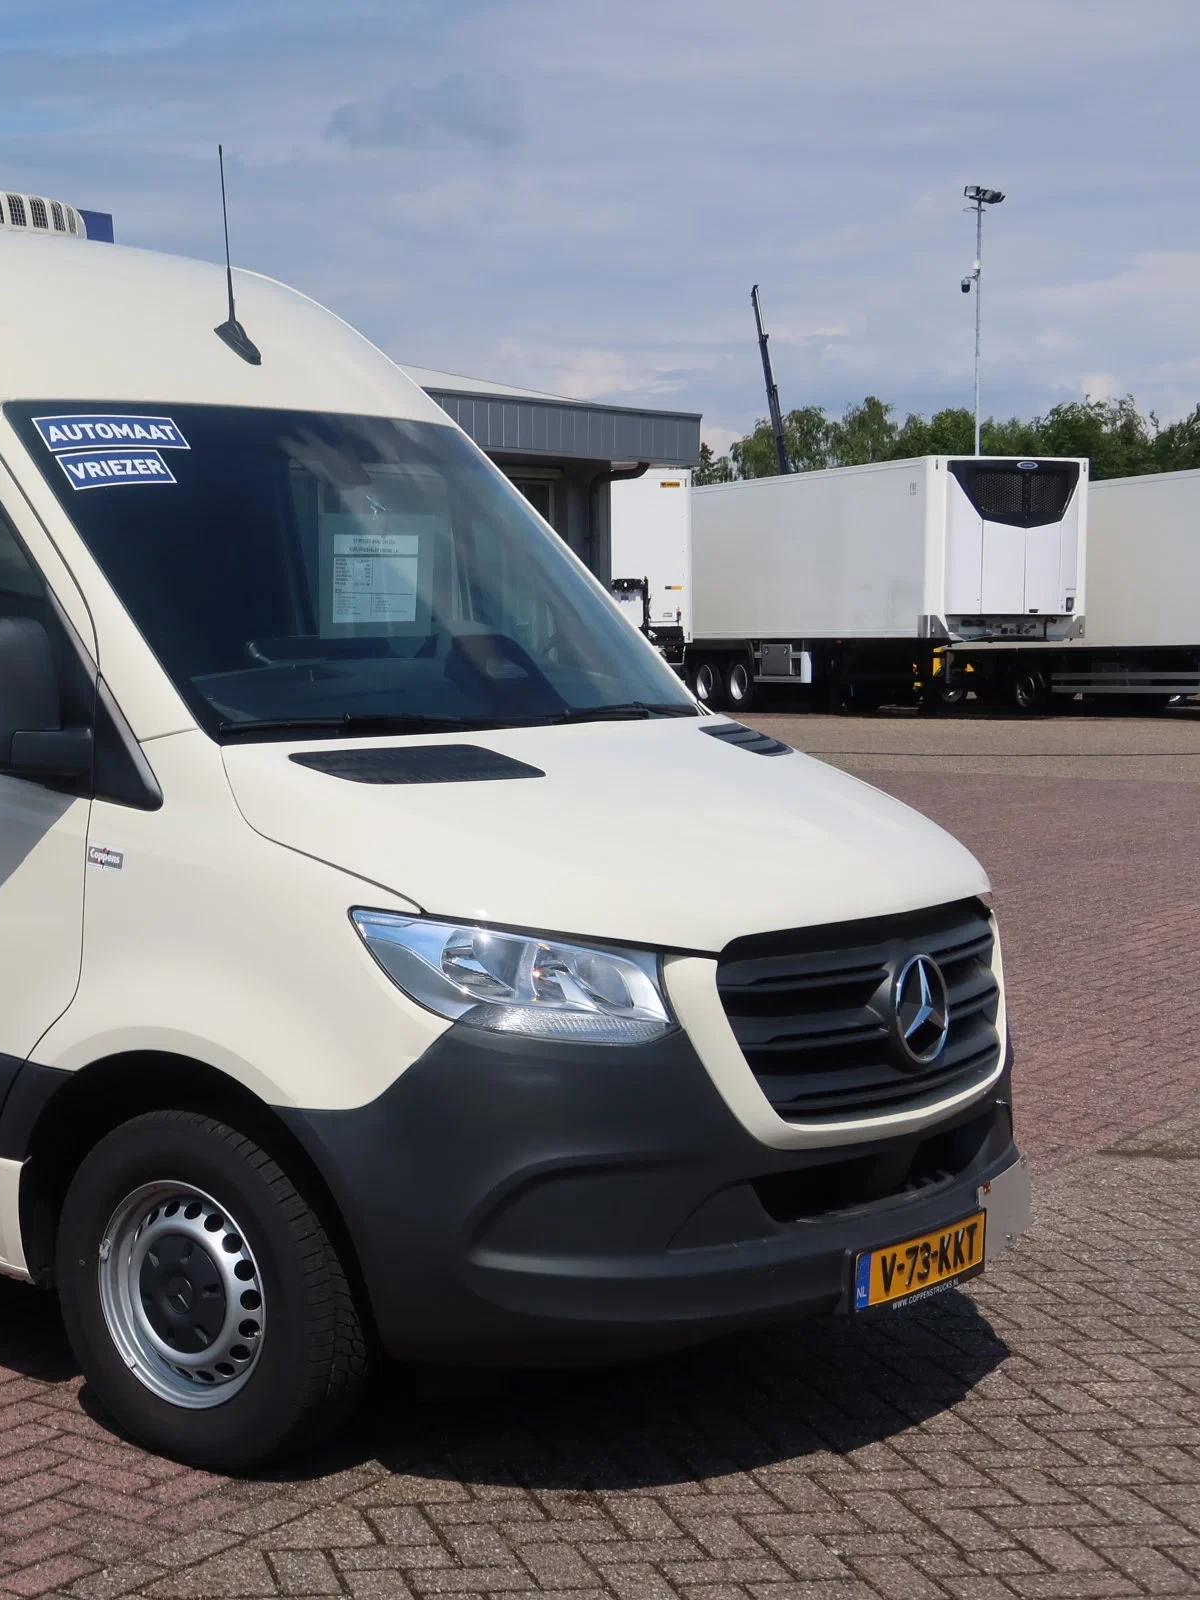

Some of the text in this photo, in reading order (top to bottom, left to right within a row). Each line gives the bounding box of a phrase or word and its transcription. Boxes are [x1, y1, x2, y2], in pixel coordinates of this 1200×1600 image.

[48, 423, 177, 443] AUTOMAAT
[66, 459, 166, 479] VRIEZER
[90, 848, 120, 864] Coppens
[881, 1222, 978, 1296] V-73-KKT
[856, 1285, 868, 1300] NL
